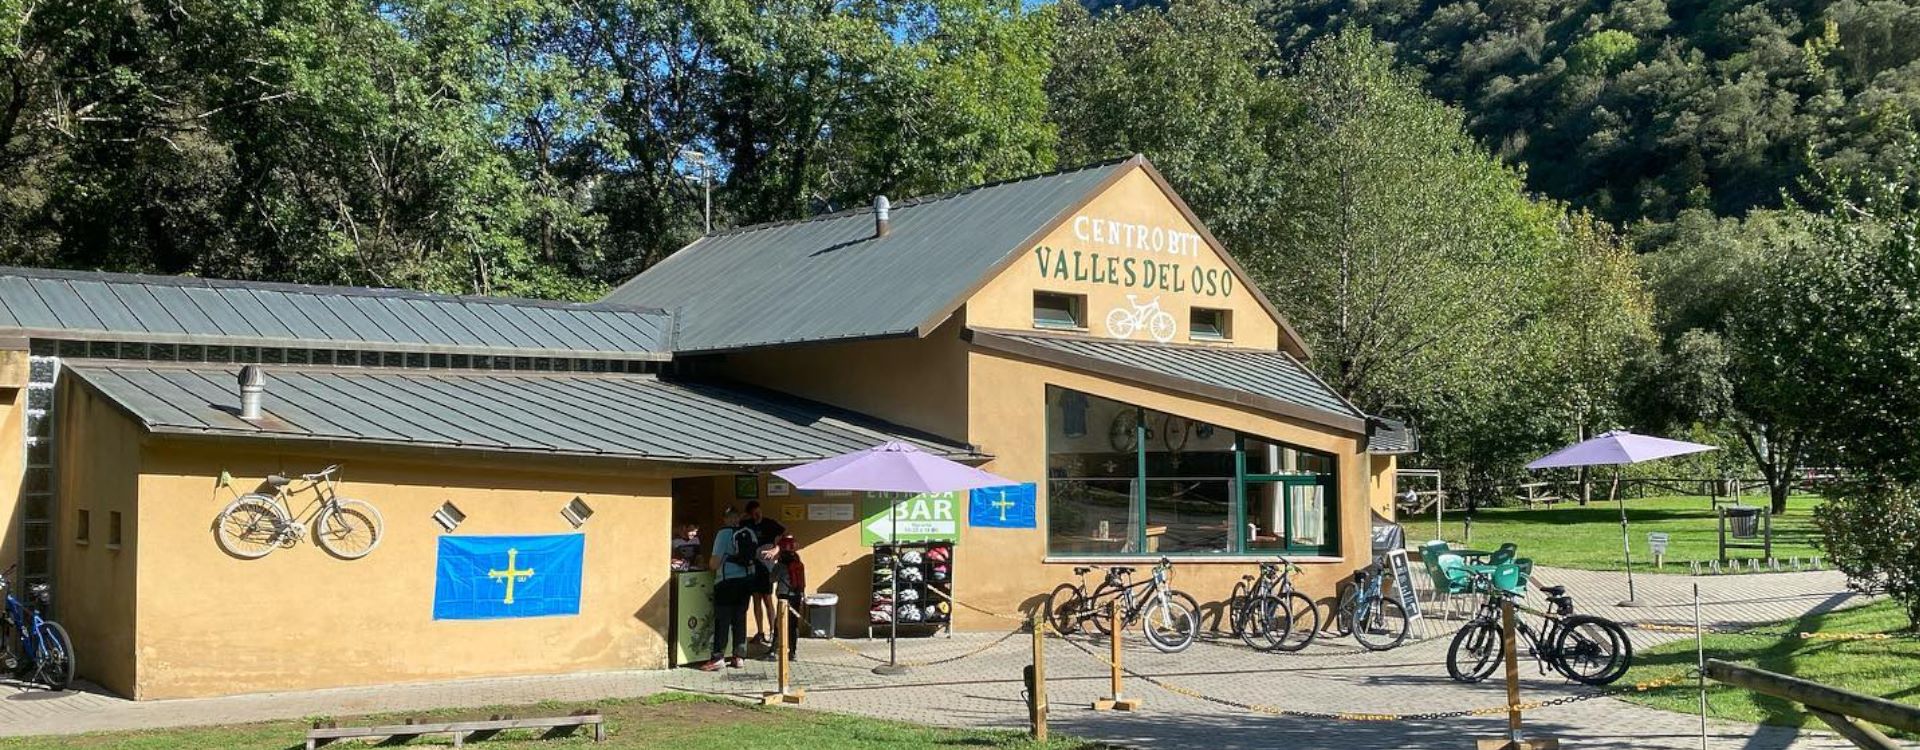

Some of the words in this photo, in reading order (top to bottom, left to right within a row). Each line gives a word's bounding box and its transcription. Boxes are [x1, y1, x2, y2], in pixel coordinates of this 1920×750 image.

[1074, 215, 1164, 252] CENTRO
[1167, 230, 1201, 257] BTT
[1034, 245, 1137, 288] VALLES
[1142, 259, 1185, 293] DEL
[1191, 265, 1233, 297] OSO
[890, 499, 953, 520] BAR
